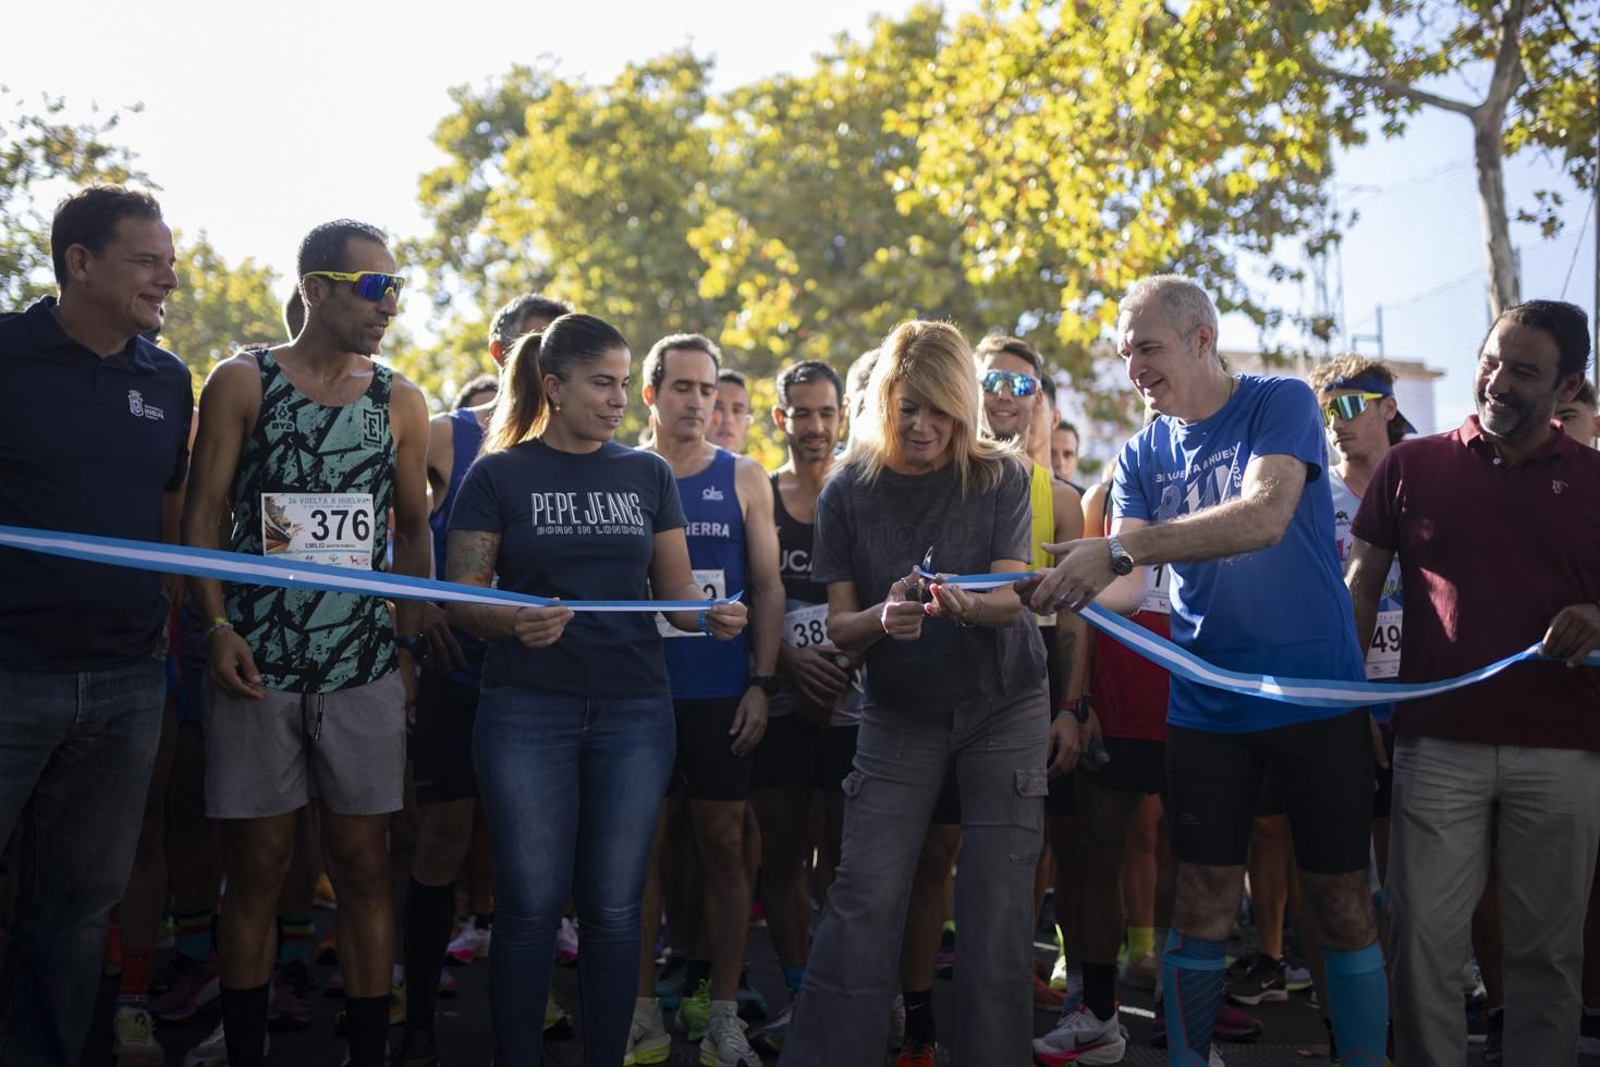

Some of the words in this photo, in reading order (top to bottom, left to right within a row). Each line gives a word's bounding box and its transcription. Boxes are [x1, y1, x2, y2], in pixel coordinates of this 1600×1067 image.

[1209, 446, 1237, 468] HUELV
[531, 492, 582, 527] PEPE
[584, 491, 644, 527] JEANS
[311, 509, 370, 541] 376
[536, 525, 573, 535] BORN
[576, 525, 592, 535] IN
[595, 525, 645, 536] LONDON
[793, 619, 829, 649] 38
